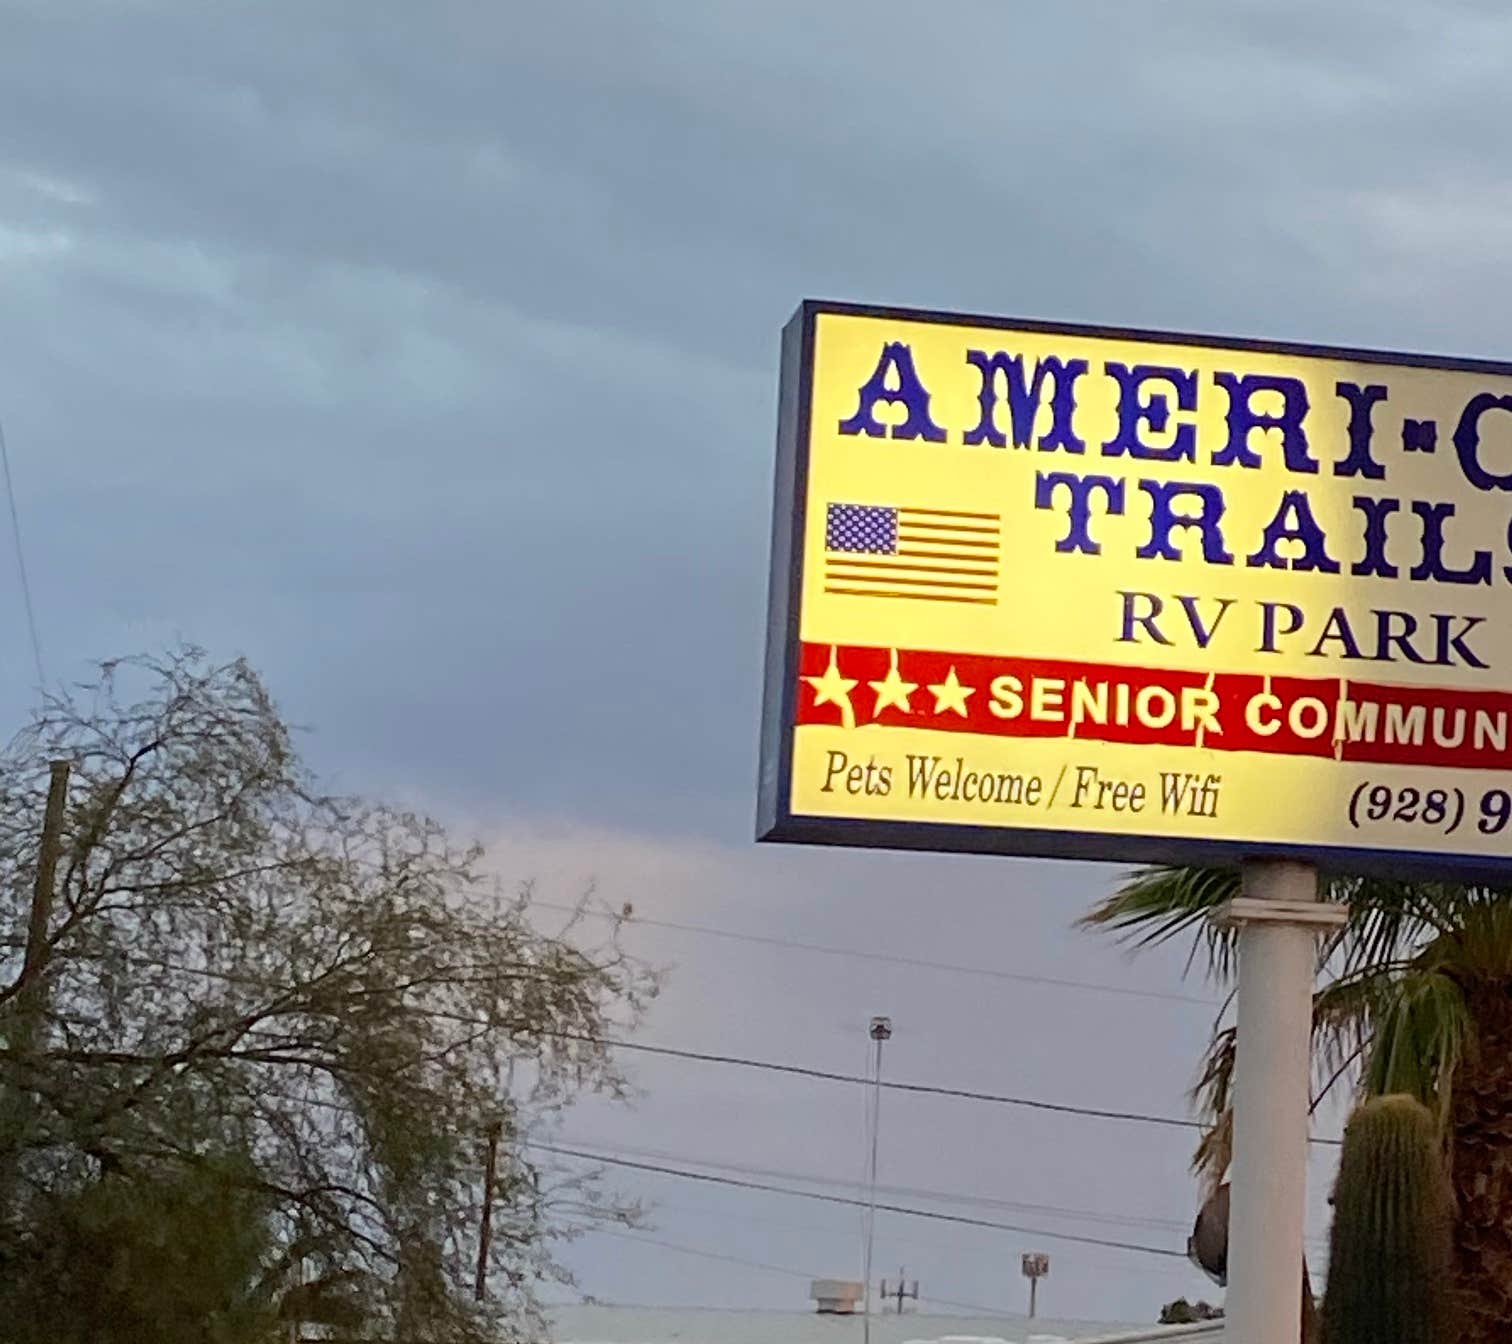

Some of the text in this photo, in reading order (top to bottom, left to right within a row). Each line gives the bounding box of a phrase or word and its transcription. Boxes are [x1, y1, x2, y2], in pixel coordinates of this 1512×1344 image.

[1113, 589, 1491, 669] RV PARK
[988, 674, 1224, 736] SENIOR
[820, 750, 893, 798] Pets
[905, 754, 1043, 806] Welcome
[1071, 765, 1147, 813] Free
[1158, 771, 1222, 818] Wifi
[1348, 781, 1465, 835] (928)
